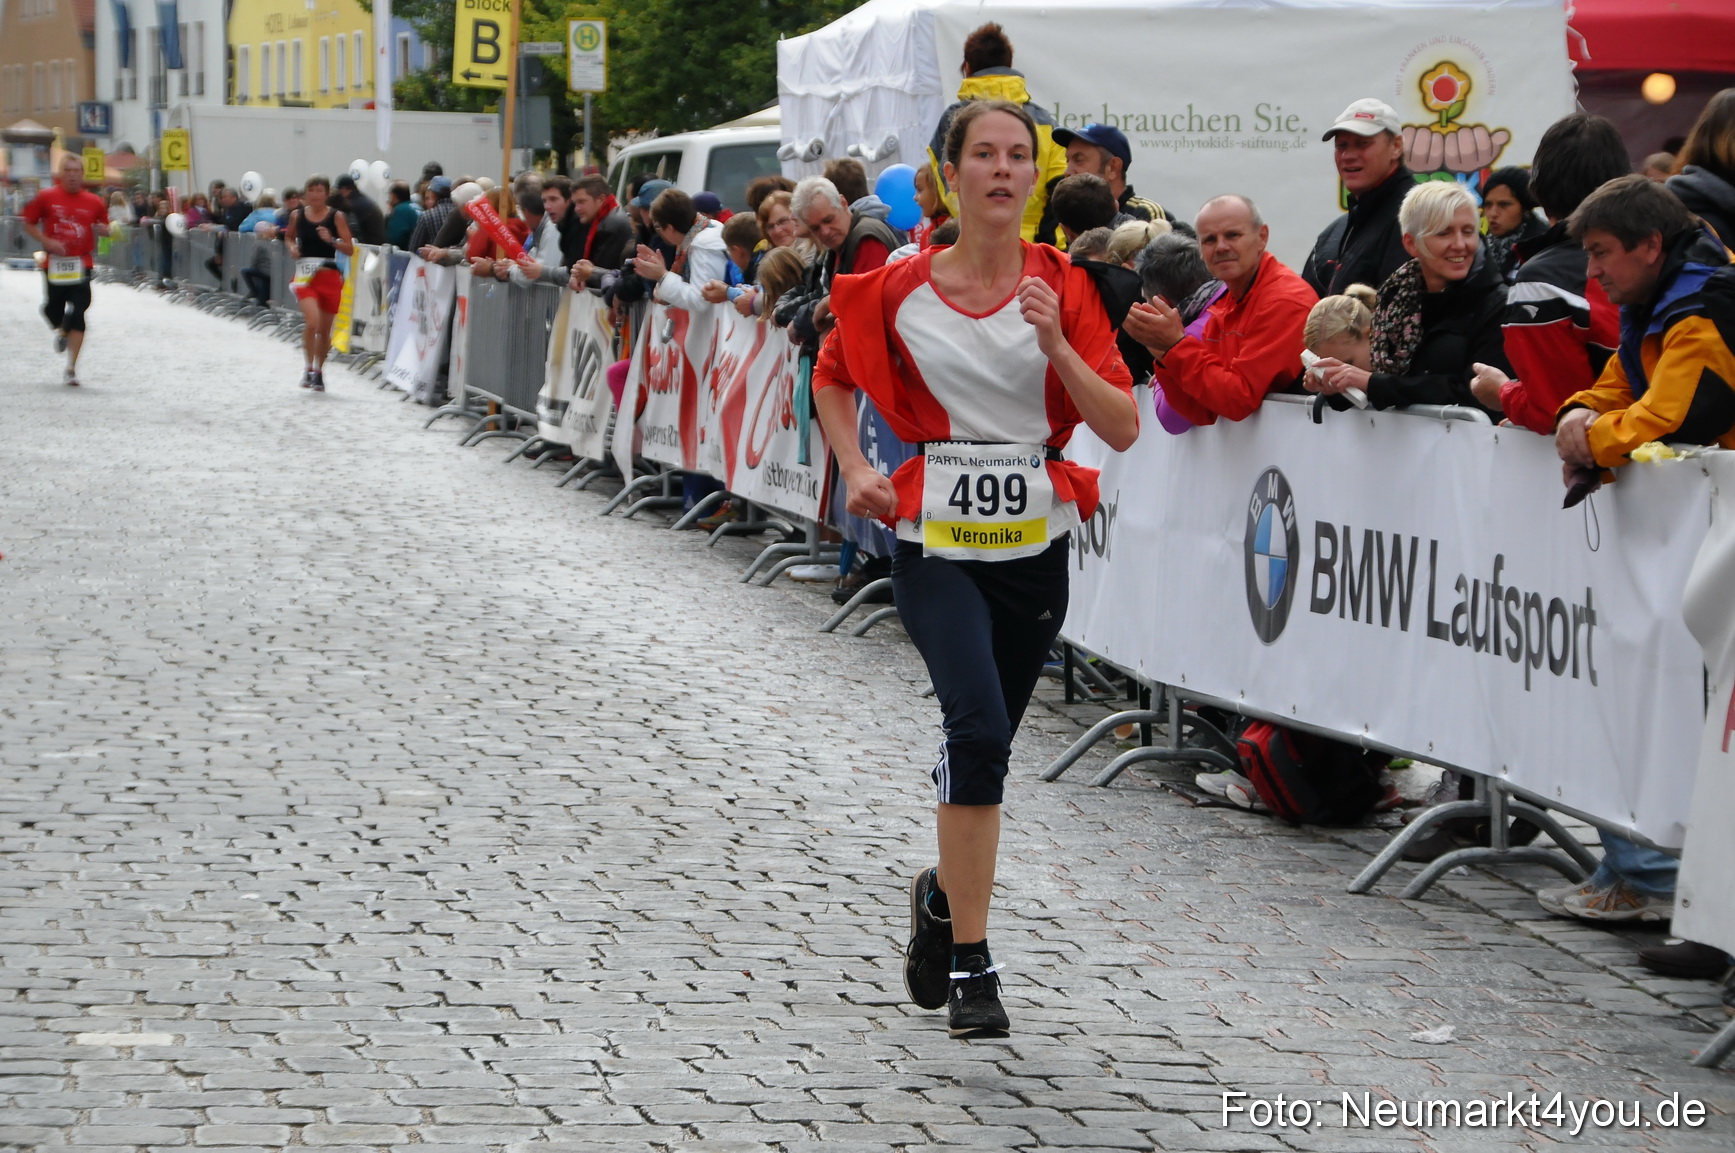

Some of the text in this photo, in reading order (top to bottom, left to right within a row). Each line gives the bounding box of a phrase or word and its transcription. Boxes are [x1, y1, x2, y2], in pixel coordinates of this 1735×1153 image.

[471, 18, 501, 64] B
[1429, 35, 1447, 46] UND
[1102, 103, 1241, 133] brauchen
[1254, 102, 1309, 133] Sie.
[168, 141, 182, 161] C
[1139, 136, 1308, 153] www.phytokids-stiftung.de
[88, 157, 99, 173] D
[480, 203, 517, 246] Audi BKK
[927, 454, 1027, 468] PARTL Neumarkt
[948, 473, 1027, 516] 499
[1250, 472, 1297, 531] BMW
[926, 511, 933, 520] D
[950, 526, 1023, 544] Veronika
[1310, 520, 1598, 692] BMW Laufsport
